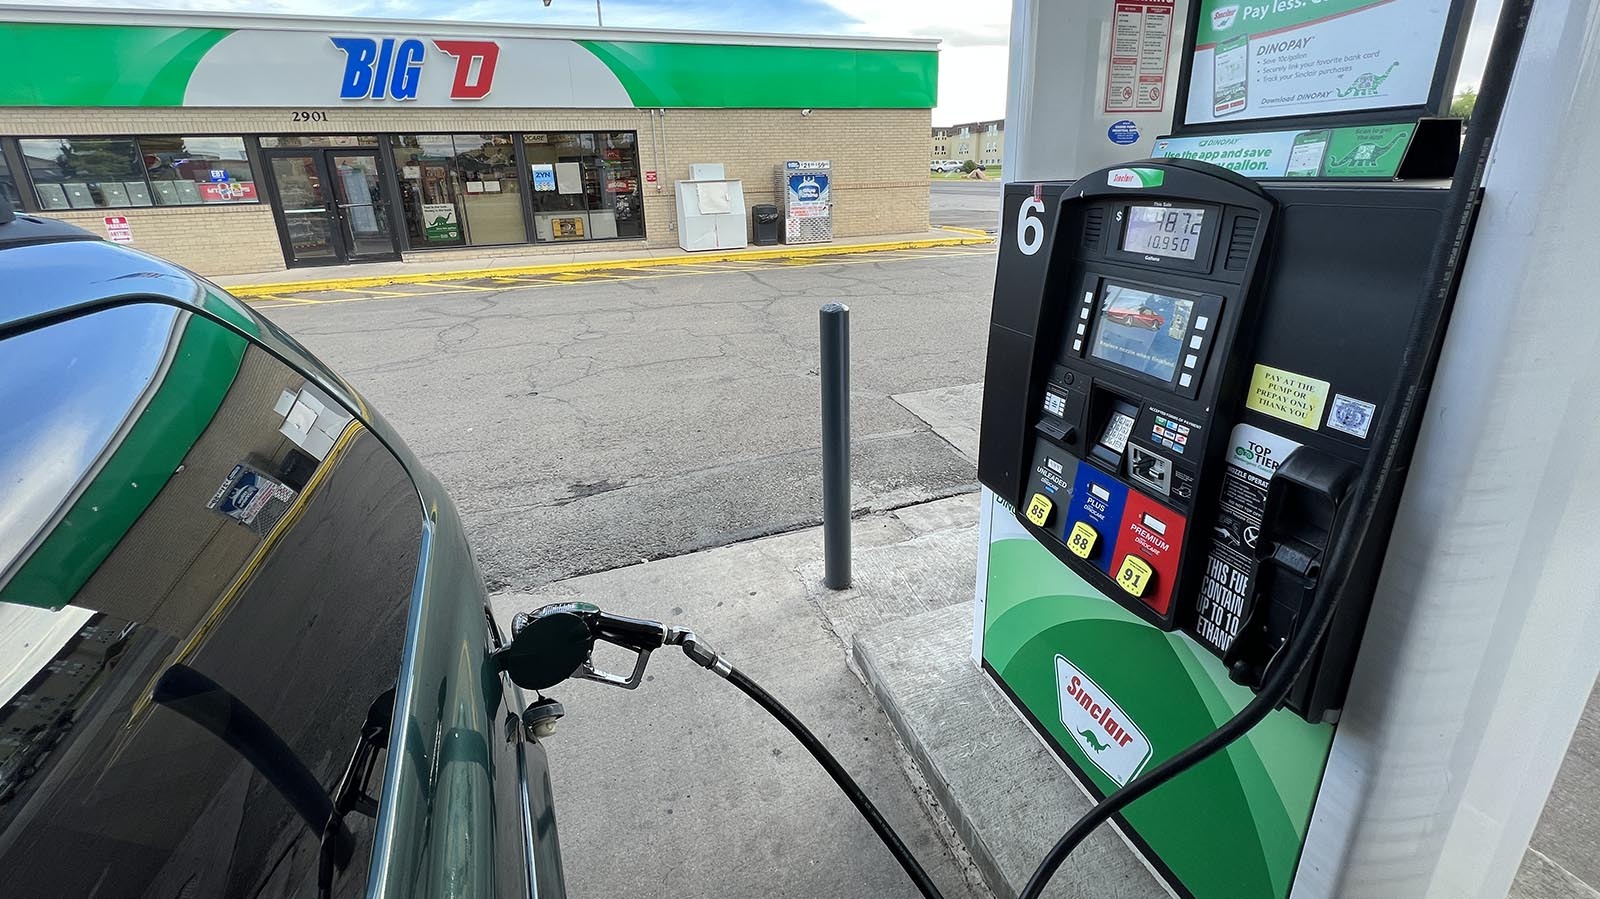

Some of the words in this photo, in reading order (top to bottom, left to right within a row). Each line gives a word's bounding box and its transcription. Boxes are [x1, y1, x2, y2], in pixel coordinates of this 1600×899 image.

[1243, 5, 1269, 20] Pay
[1257, 37, 1312, 56] DINOPAY
[329, 36, 425, 101] BIG
[432, 39, 500, 101] D
[1300, 61, 1315, 70] your
[1316, 57, 1342, 66] favorite
[1344, 54, 1362, 62] bank
[1362, 50, 1380, 59] card
[1280, 73, 1293, 81] your
[1318, 66, 1353, 77] purchases
[1261, 94, 1295, 105] Download
[1297, 91, 1331, 100] DINOPAY
[292, 111, 329, 122] 2901
[1207, 138, 1240, 146] DINOPAY
[1182, 150, 1198, 159] the
[1199, 151, 1220, 161] app
[1220, 148, 1243, 158] and
[1243, 148, 1272, 158] save
[1226, 159, 1269, 171] gallon.
[211, 170, 226, 178] EBT
[1113, 174, 1134, 182] Sinclair
[1116, 211, 1123, 222] $
[1017, 196, 1046, 256] 6
[1147, 235, 1190, 252] 10.950
[1265, 372, 1282, 382] PAY
[1283, 378, 1295, 387] AT
[1297, 381, 1316, 393] THE
[1268, 382, 1293, 396] PUMP
[1293, 390, 1307, 399] OR
[1256, 388, 1289, 404] PREPAY
[1290, 398, 1315, 412] ONLY
[1258, 397, 1288, 413] THANK
[1288, 407, 1309, 420] YOU
[1248, 440, 1272, 457] TOP
[1254, 453, 1279, 471] TIER
[1036, 466, 1068, 489] UNLEADED
[1031, 504, 1045, 519] 85
[1087, 497, 1106, 512] PLUS
[1073, 533, 1089, 550] 88
[1130, 523, 1170, 552] PREMIUM
[1134, 537, 1161, 556] DINOCARE
[1123, 568, 1141, 588] 91
[1207, 555, 1229, 585] THIS
[1196, 593, 1210, 615] UP
[1211, 602, 1224, 626] TO
[1225, 613, 1240, 637] 10
[1066, 675, 1134, 747] Sinclair
